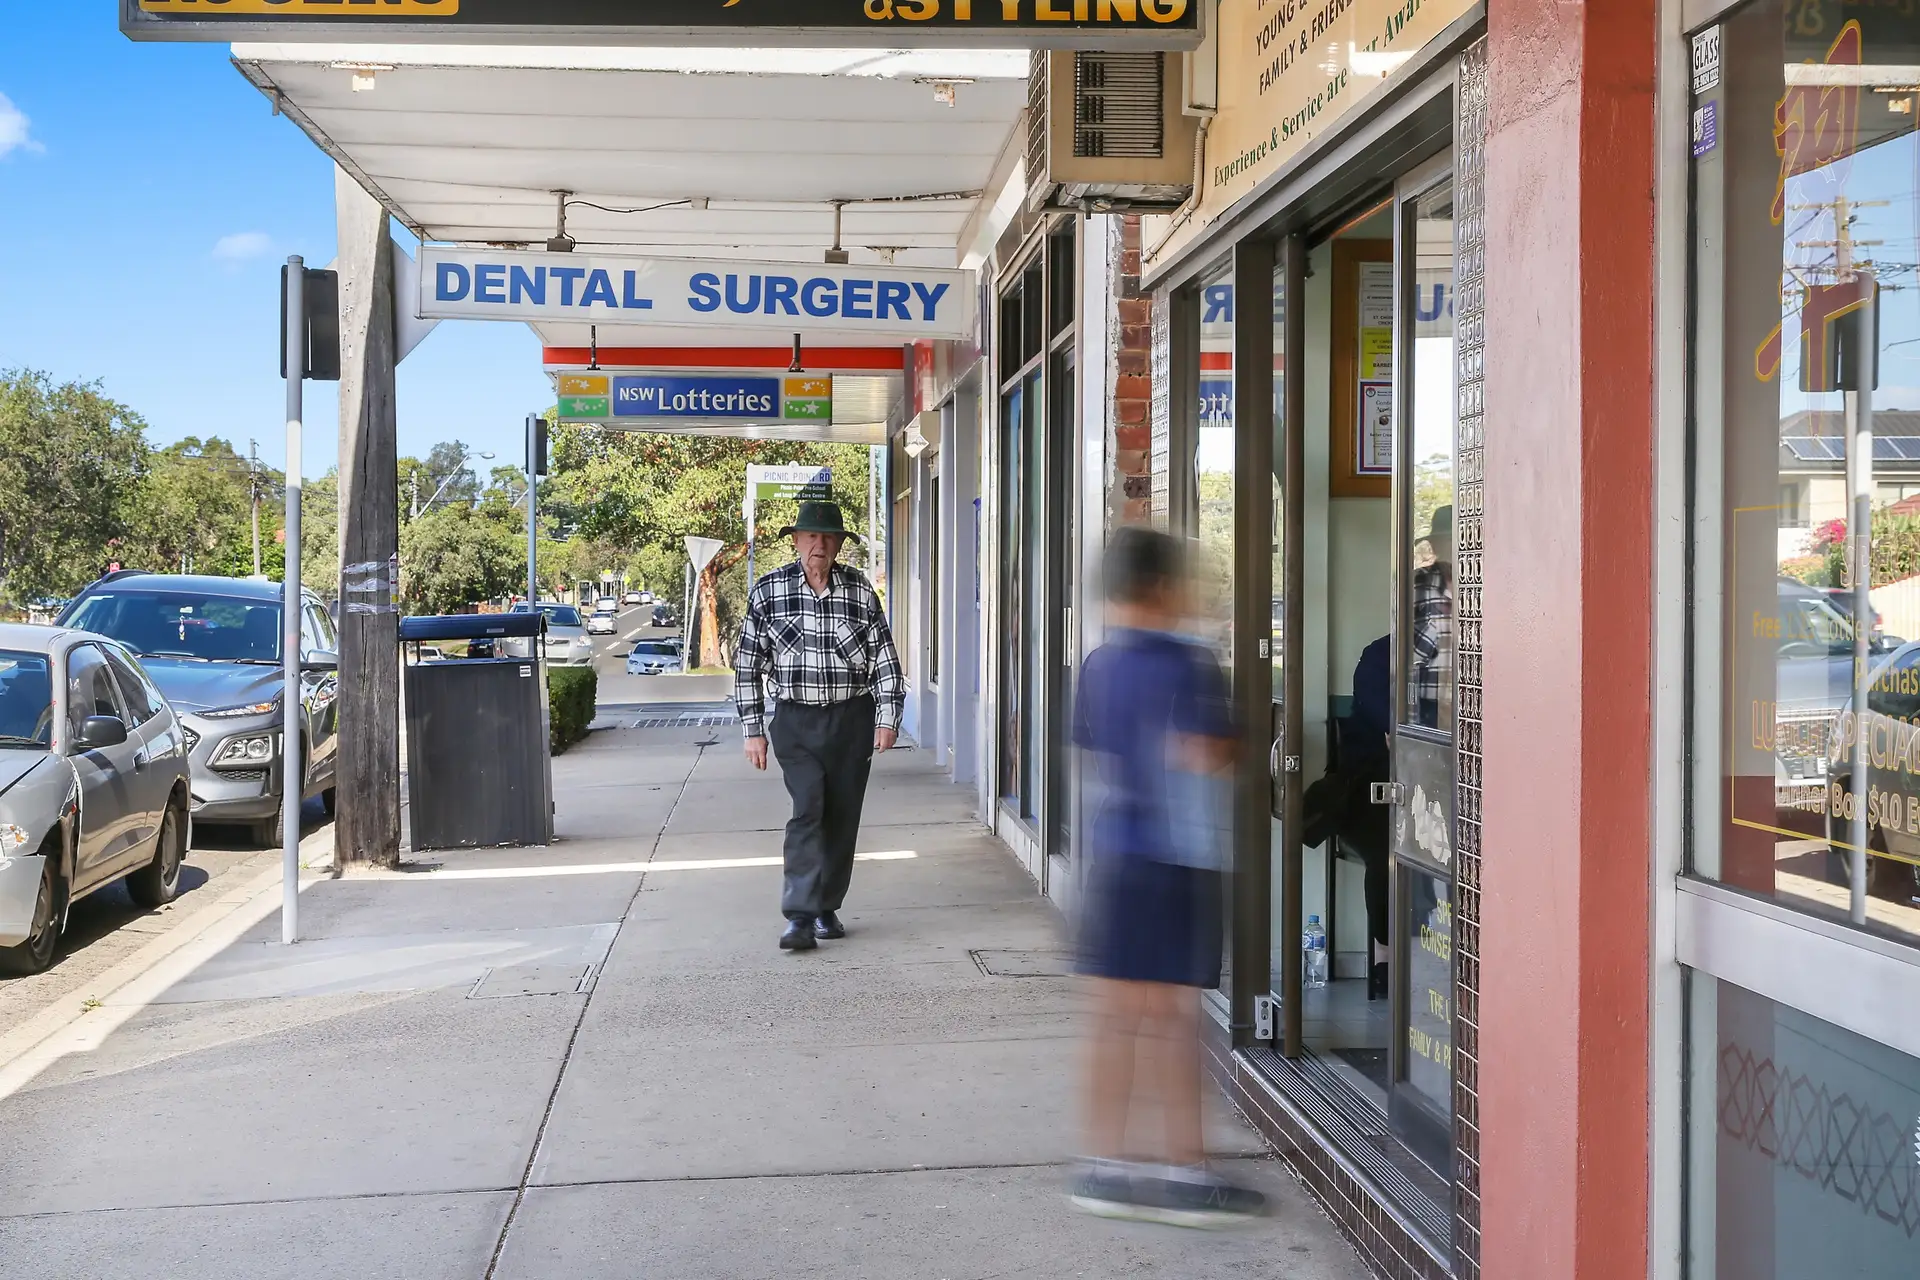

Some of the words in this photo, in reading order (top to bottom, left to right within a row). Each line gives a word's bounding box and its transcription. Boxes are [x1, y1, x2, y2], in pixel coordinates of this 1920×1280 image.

[1256, 0, 1295, 56] YOUNG
[1259, 39, 1296, 96] FAMILY
[1299, 29, 1308, 55] &
[1694, 35, 1718, 70] GLASS
[1214, 141, 1267, 187] Experience
[1270, 127, 1278, 151] &
[1282, 93, 1323, 141] Service
[1327, 68, 1347, 102] are
[436, 262, 653, 310] DENTAL
[688, 272, 950, 321] SURGERY
[619, 387, 654, 401] NSW
[658, 388, 771, 412] Lotteries
[764, 471, 789, 482] PICNIC
[793, 472, 815, 482] POINT
[819, 472, 830, 482] RD
[1753, 611, 1781, 639] Free
[1831, 782, 1865, 821] Box
[1868, 784, 1902, 830] $10
[1409, 1026, 1432, 1059] FAMILY
[1434, 1040, 1441, 1064] &
